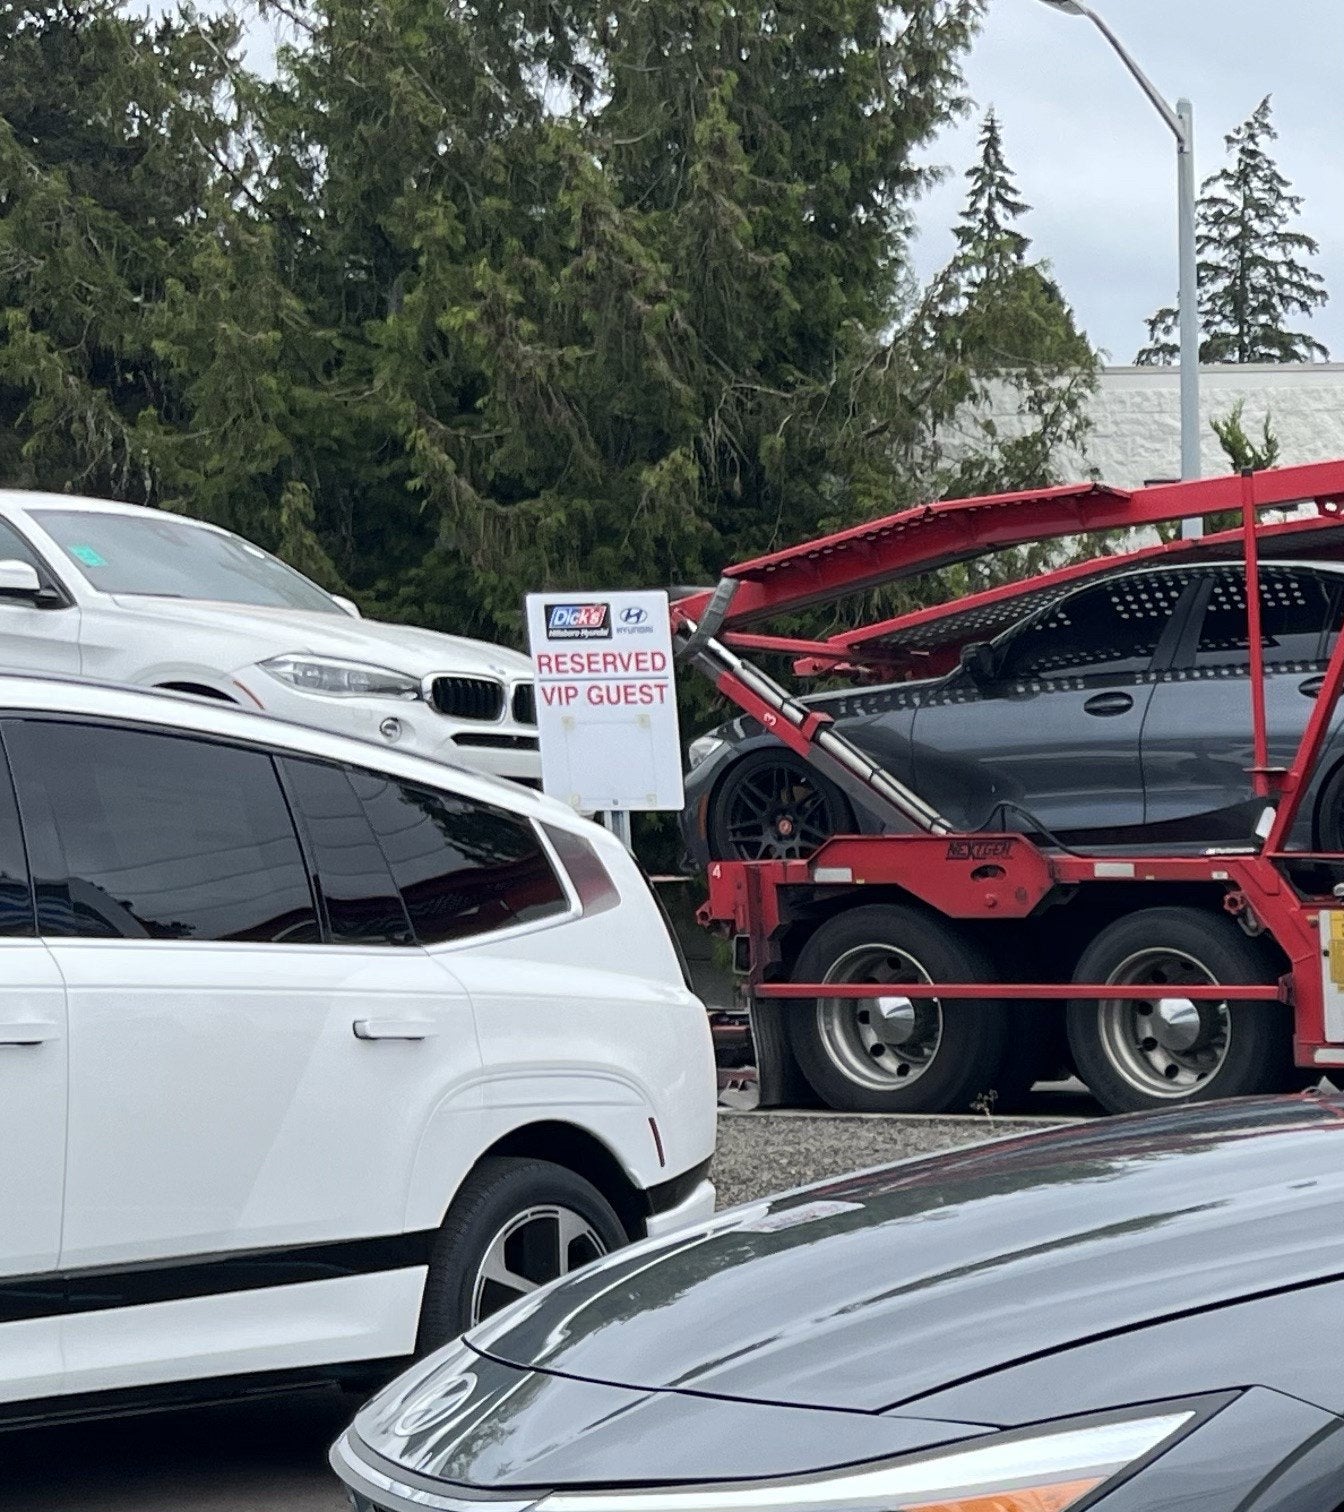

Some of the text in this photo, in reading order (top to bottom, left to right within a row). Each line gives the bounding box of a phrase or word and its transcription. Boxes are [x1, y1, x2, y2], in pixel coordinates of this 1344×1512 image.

[537, 652, 667, 674] RESERVED
[542, 684, 668, 706] VIP GUEST
